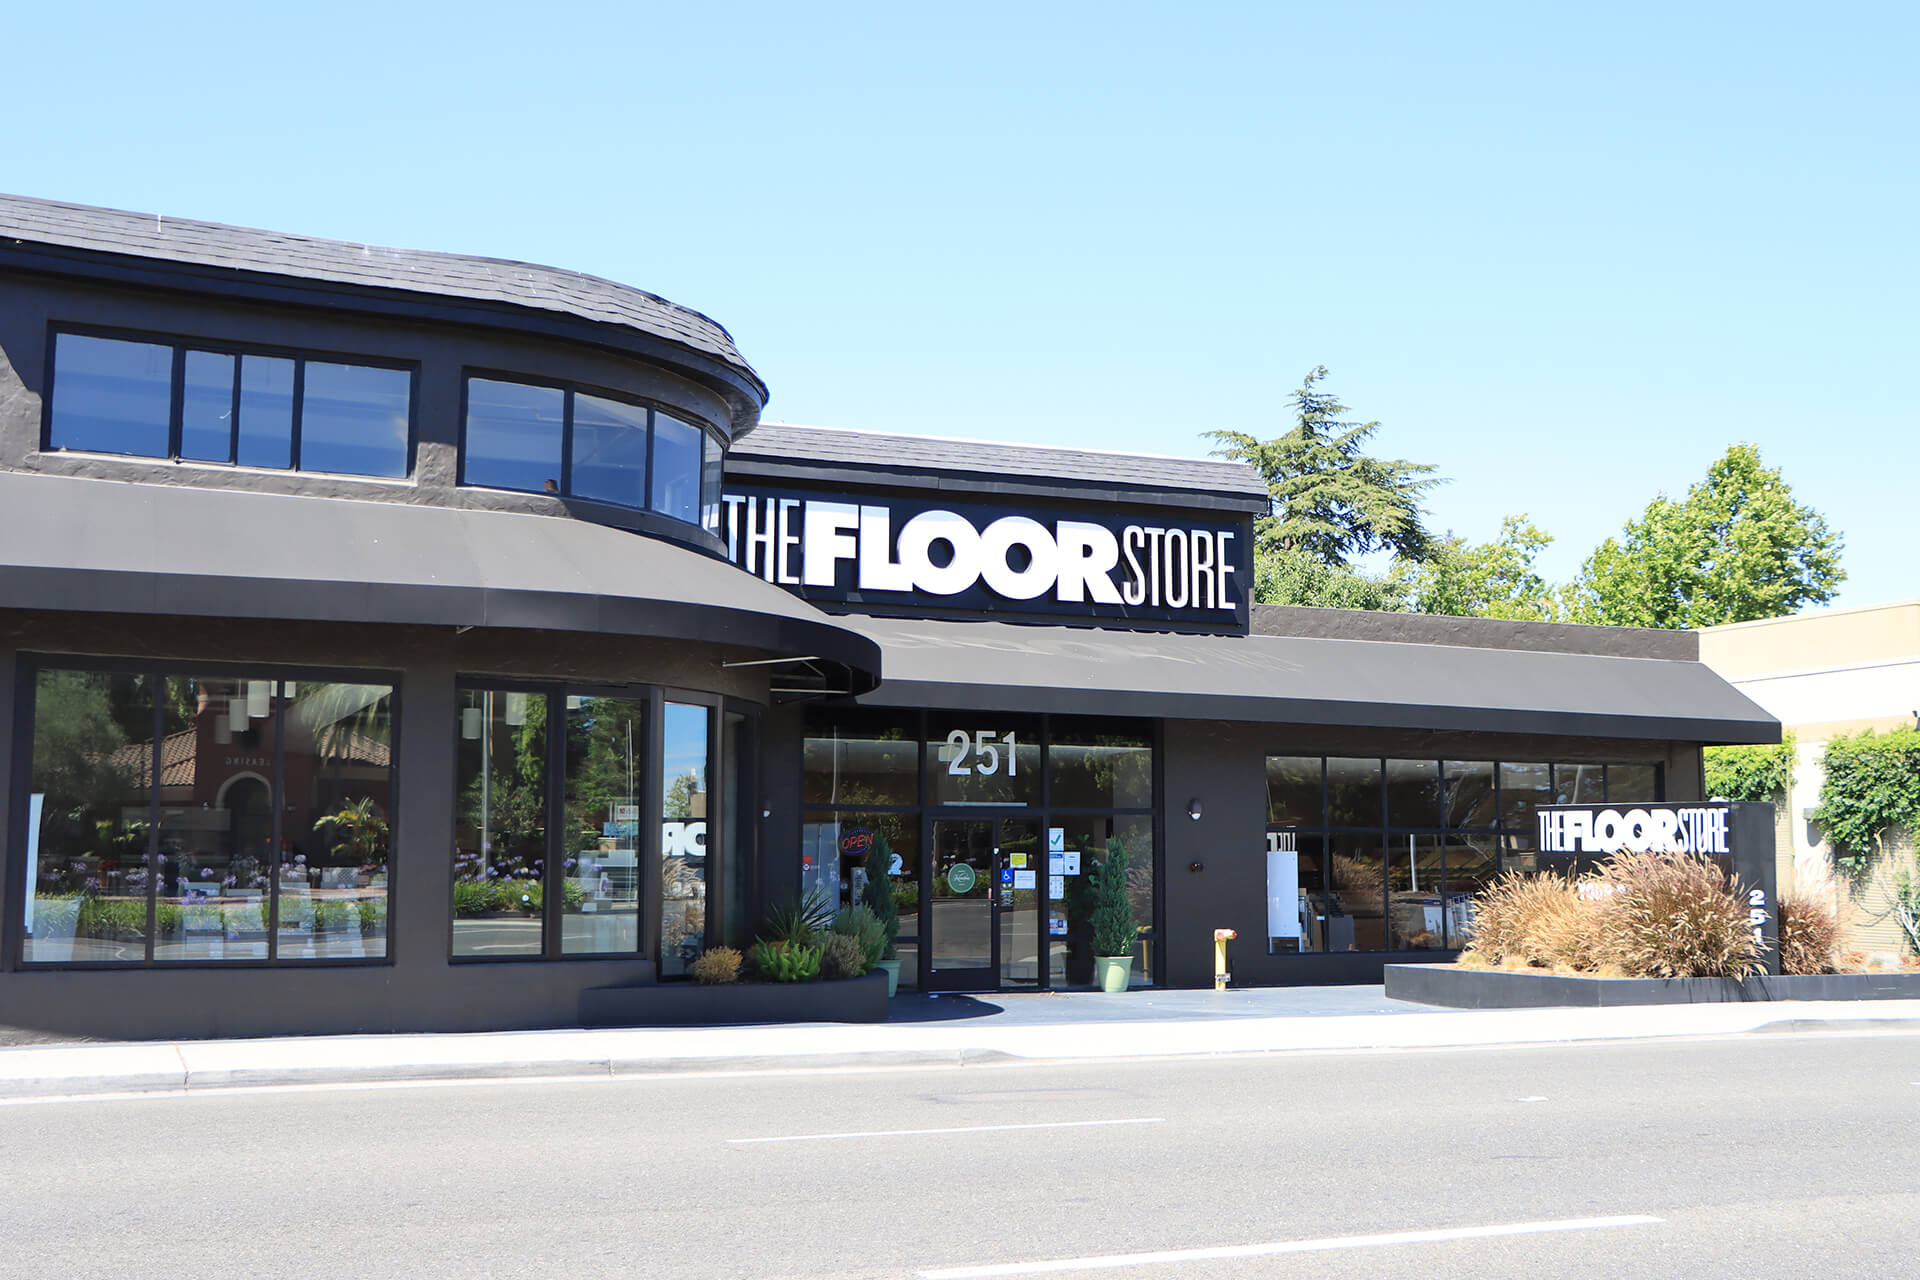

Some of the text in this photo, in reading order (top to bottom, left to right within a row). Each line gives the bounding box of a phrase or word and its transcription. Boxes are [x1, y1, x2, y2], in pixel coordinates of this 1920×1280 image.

[722, 494, 1235, 609] THE FLOOR STORE
[946, 729, 1016, 776] 251
[841, 833, 874, 849] OPEN
[1537, 807, 1730, 853] THE FLOOR STORE
